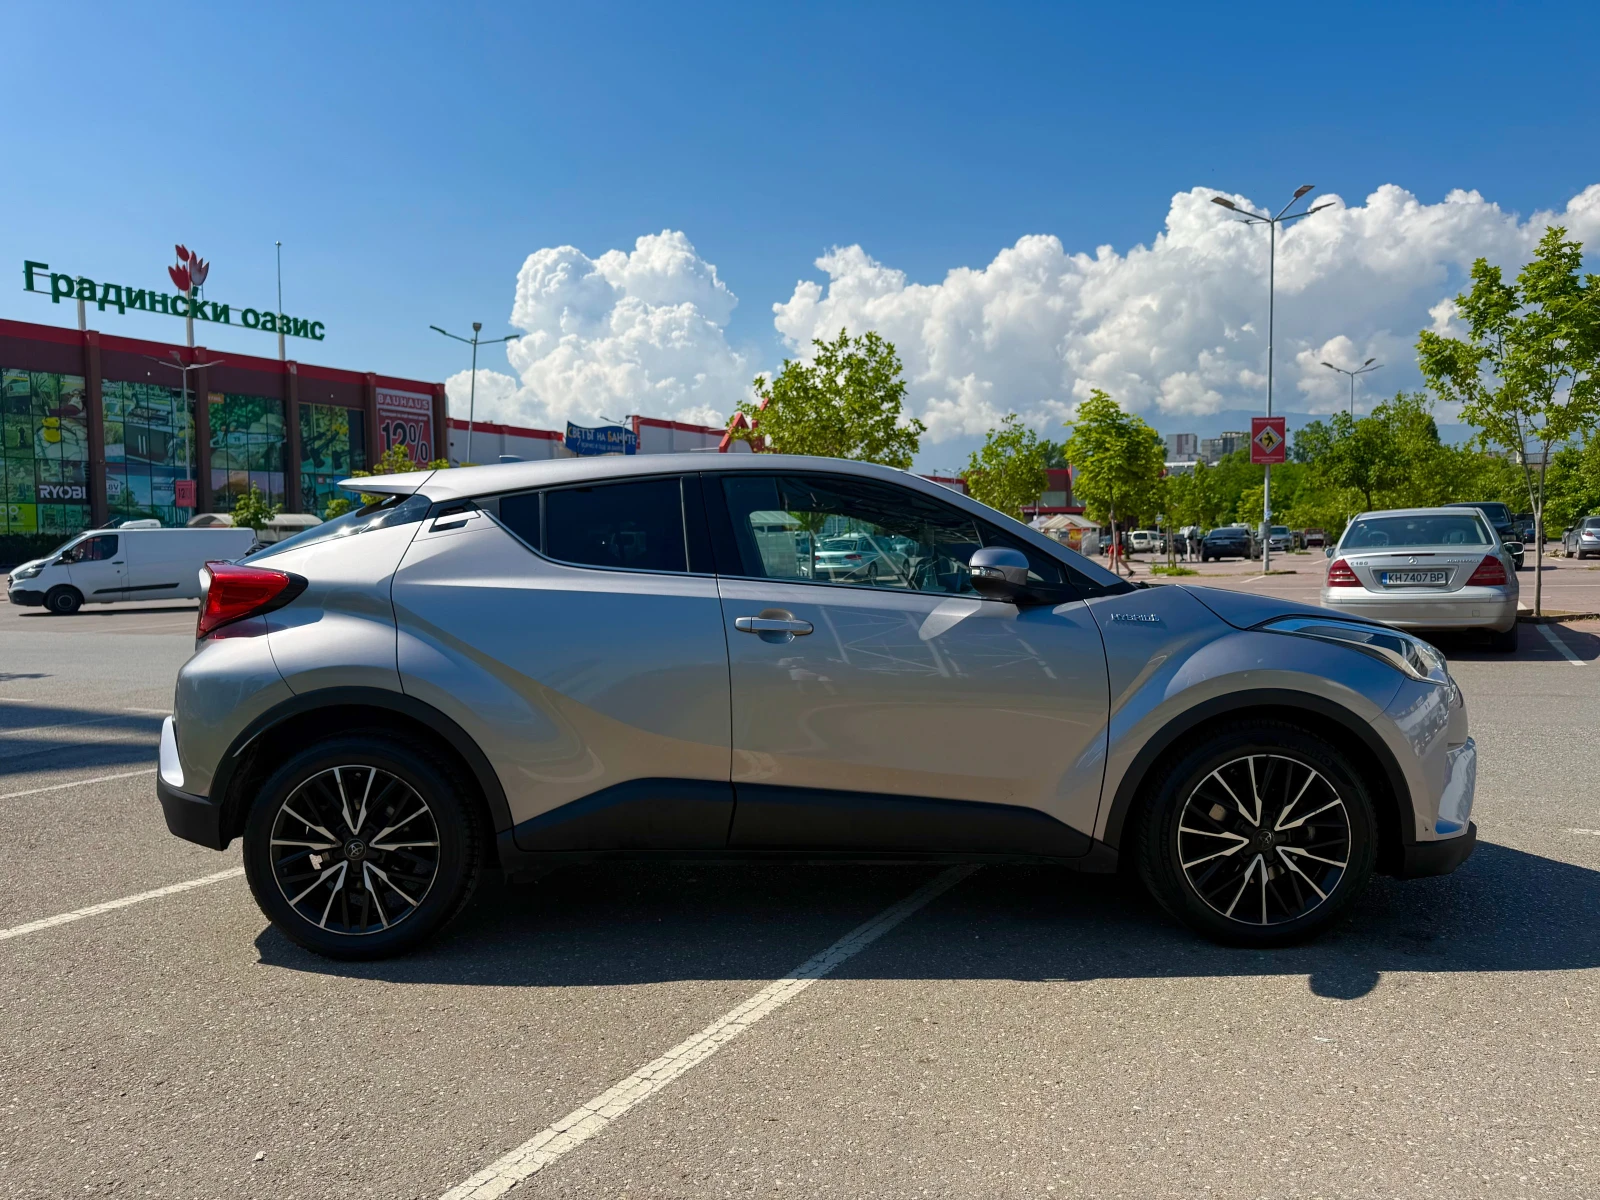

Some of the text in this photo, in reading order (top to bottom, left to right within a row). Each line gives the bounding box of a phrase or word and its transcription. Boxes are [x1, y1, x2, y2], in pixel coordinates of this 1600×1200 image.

[24, 260, 325, 342] Градински оазис
[377, 394, 429, 410] BAUHAUS
[380, 420, 429, 463] 12%
[38, 484, 87, 499] RYOBI
